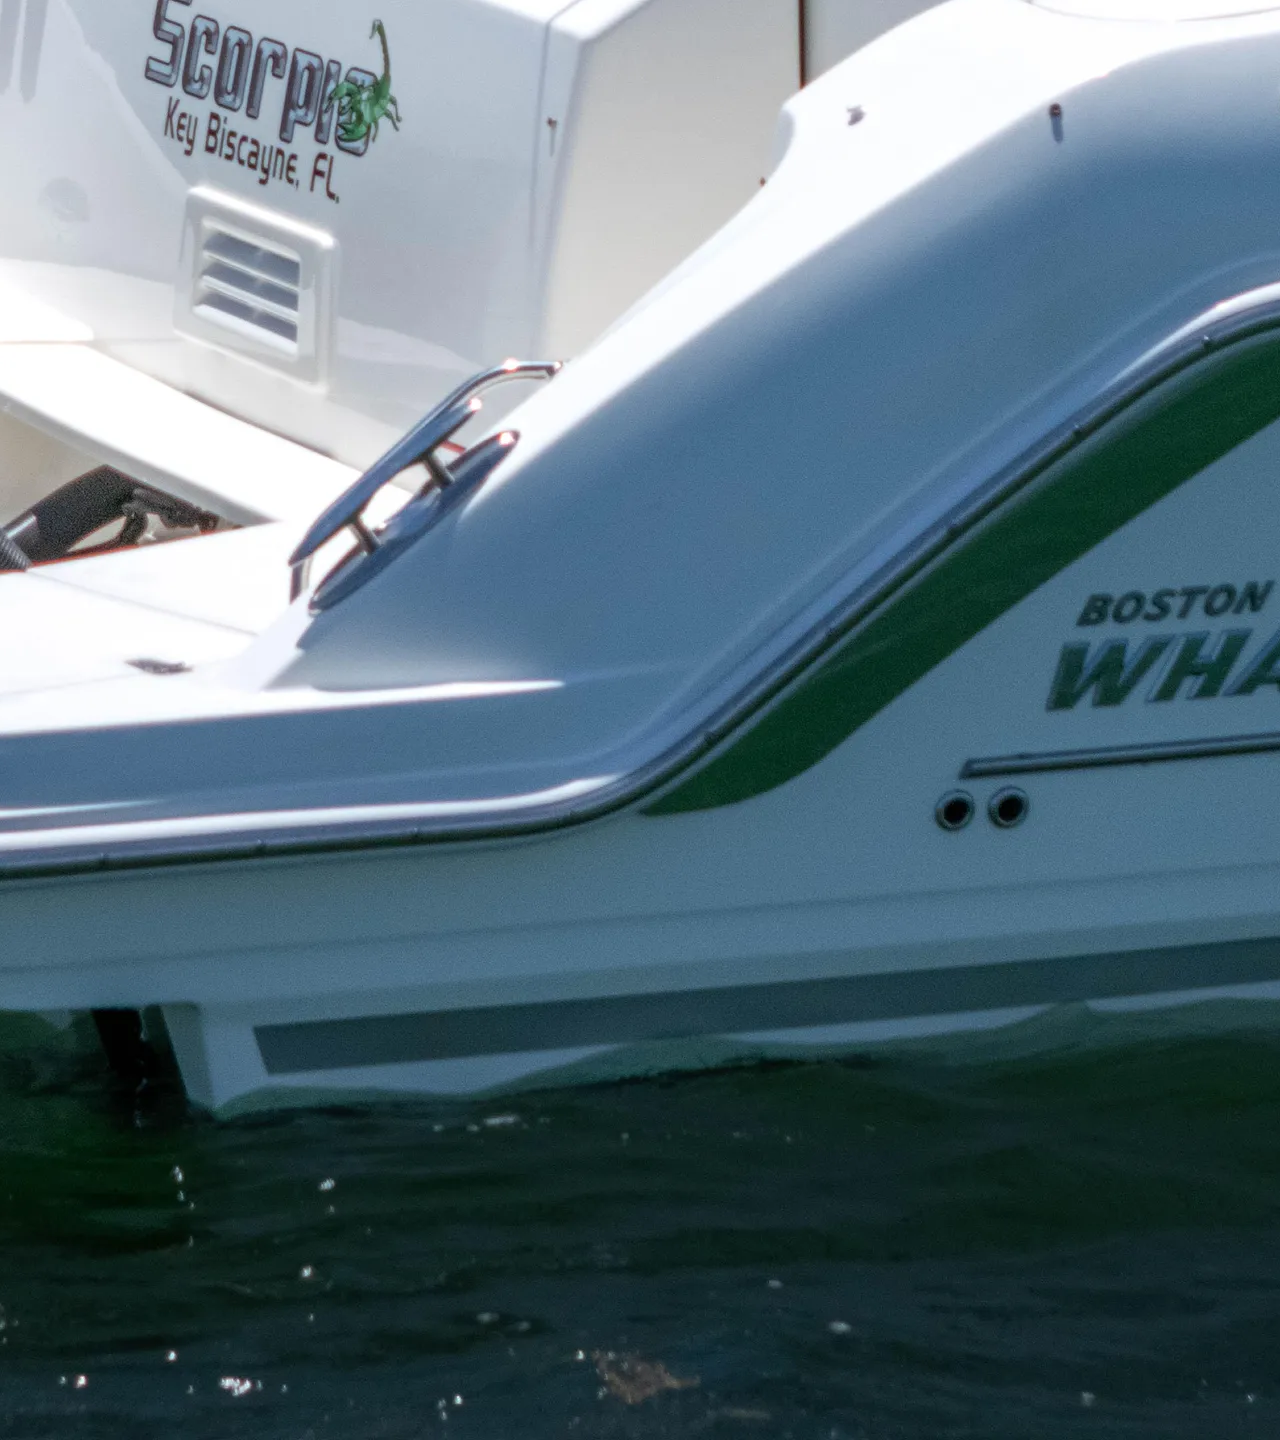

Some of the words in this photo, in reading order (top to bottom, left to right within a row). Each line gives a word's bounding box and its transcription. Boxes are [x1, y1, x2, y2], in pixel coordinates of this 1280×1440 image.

[163, 95, 199, 157] Key
[204, 110, 301, 191] Biscayne,
[1075, 579, 1275, 628] BOSTON
